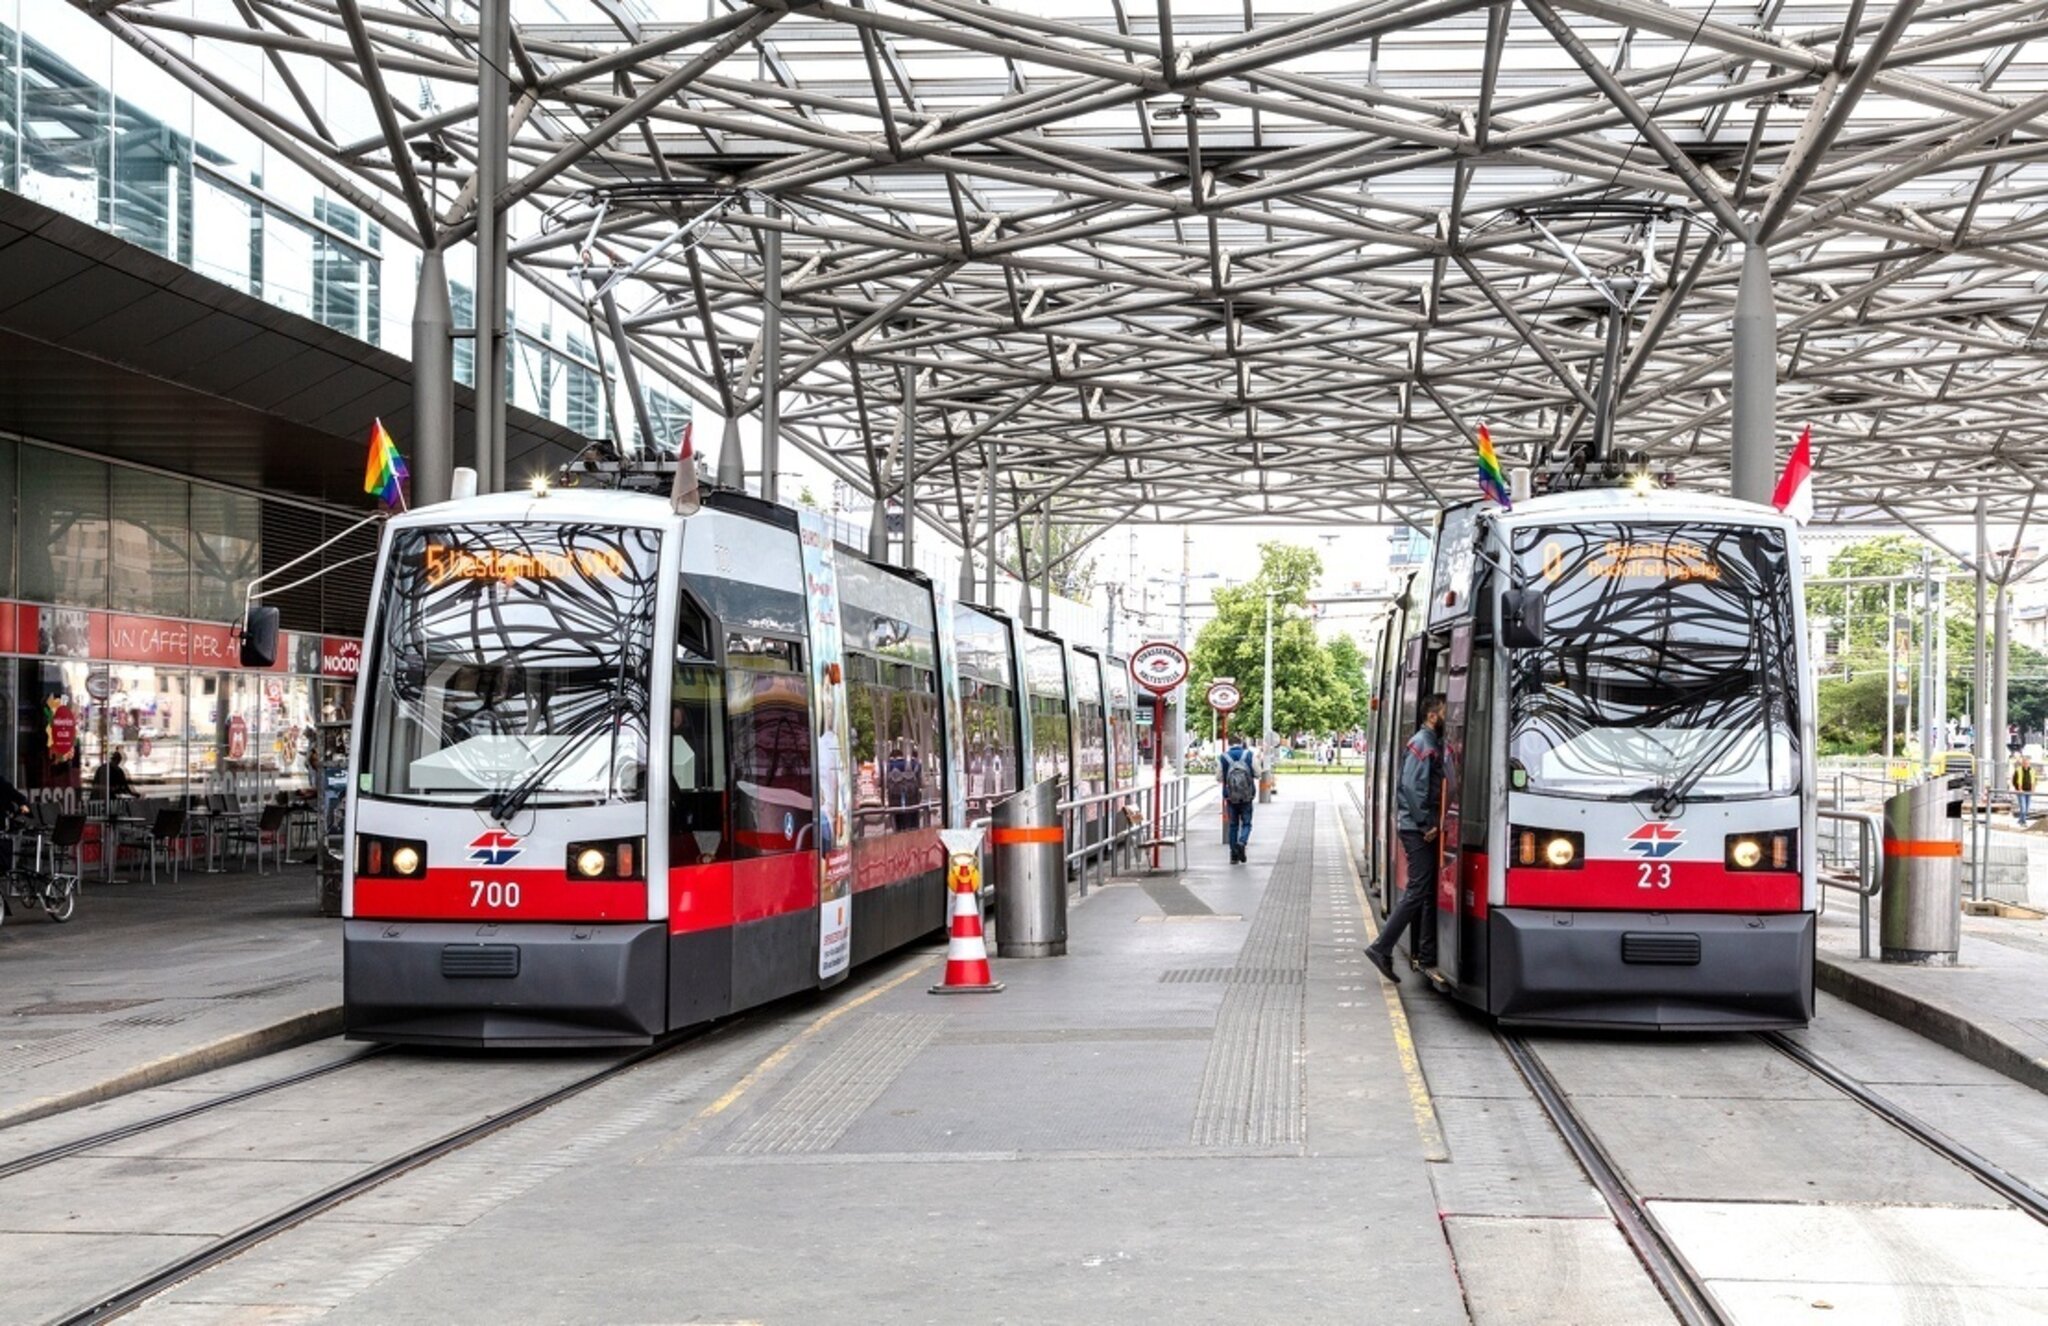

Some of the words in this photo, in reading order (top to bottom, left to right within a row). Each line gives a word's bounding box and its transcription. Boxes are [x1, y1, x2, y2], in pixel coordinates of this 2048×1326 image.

[426, 545, 446, 583] 5
[111, 629, 134, 648] UN
[140, 624, 188, 655] CAFFÈ
[193, 634, 222, 658] PER
[1637, 863, 1672, 889] 23
[470, 880, 520, 908] 700
